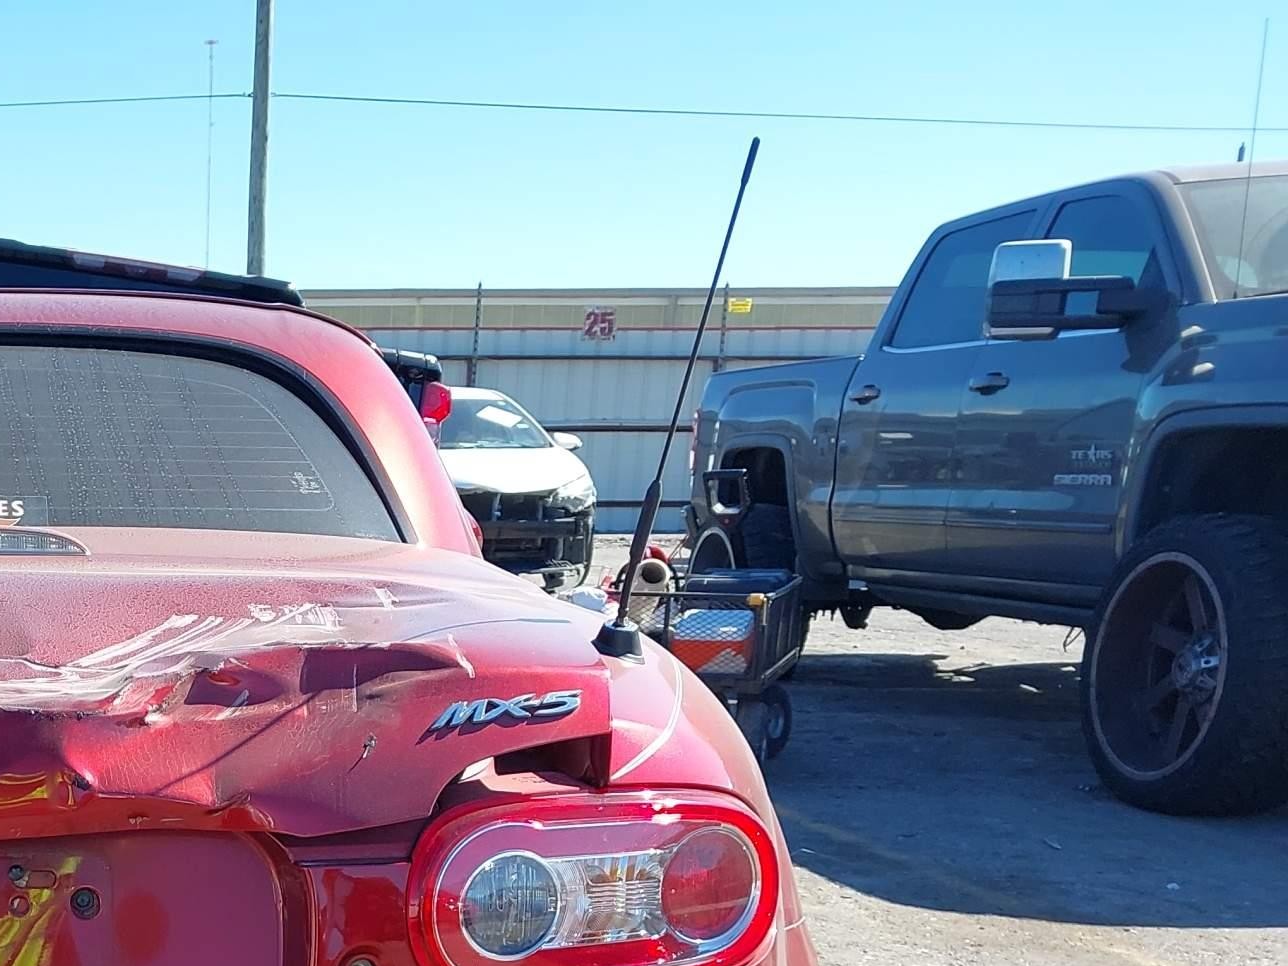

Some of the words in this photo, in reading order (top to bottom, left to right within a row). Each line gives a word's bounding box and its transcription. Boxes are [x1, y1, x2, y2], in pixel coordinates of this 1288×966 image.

[585, 311, 615, 338] 25
[1054, 474, 1112, 486] SIERRA
[430, 689, 584, 730] MX-5
